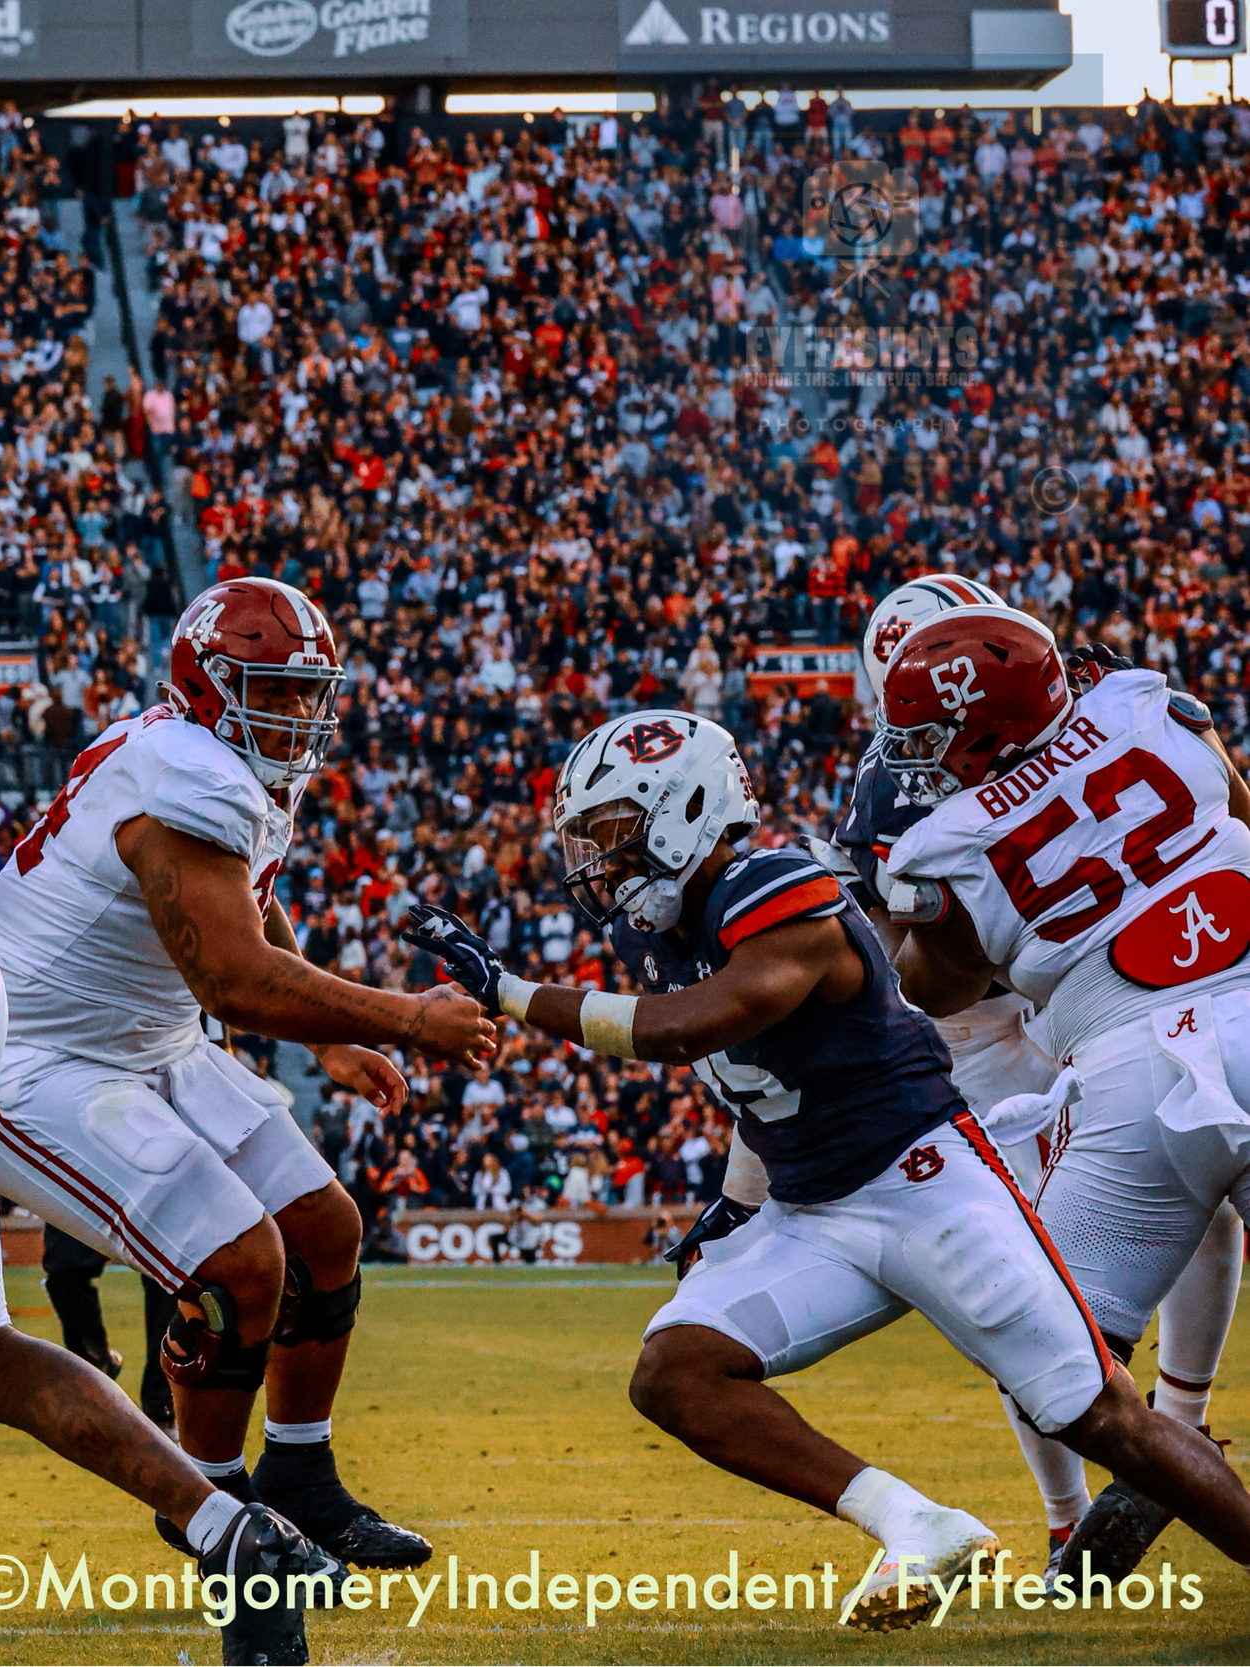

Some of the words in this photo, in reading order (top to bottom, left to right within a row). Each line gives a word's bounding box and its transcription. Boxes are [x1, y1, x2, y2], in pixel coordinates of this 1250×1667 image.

[334, 17, 429, 57] Flake
[185, 599, 226, 644] 74
[929, 655, 986, 710] 52
[975, 716, 1109, 820] BOOKER
[984, 746, 1218, 944] 52
